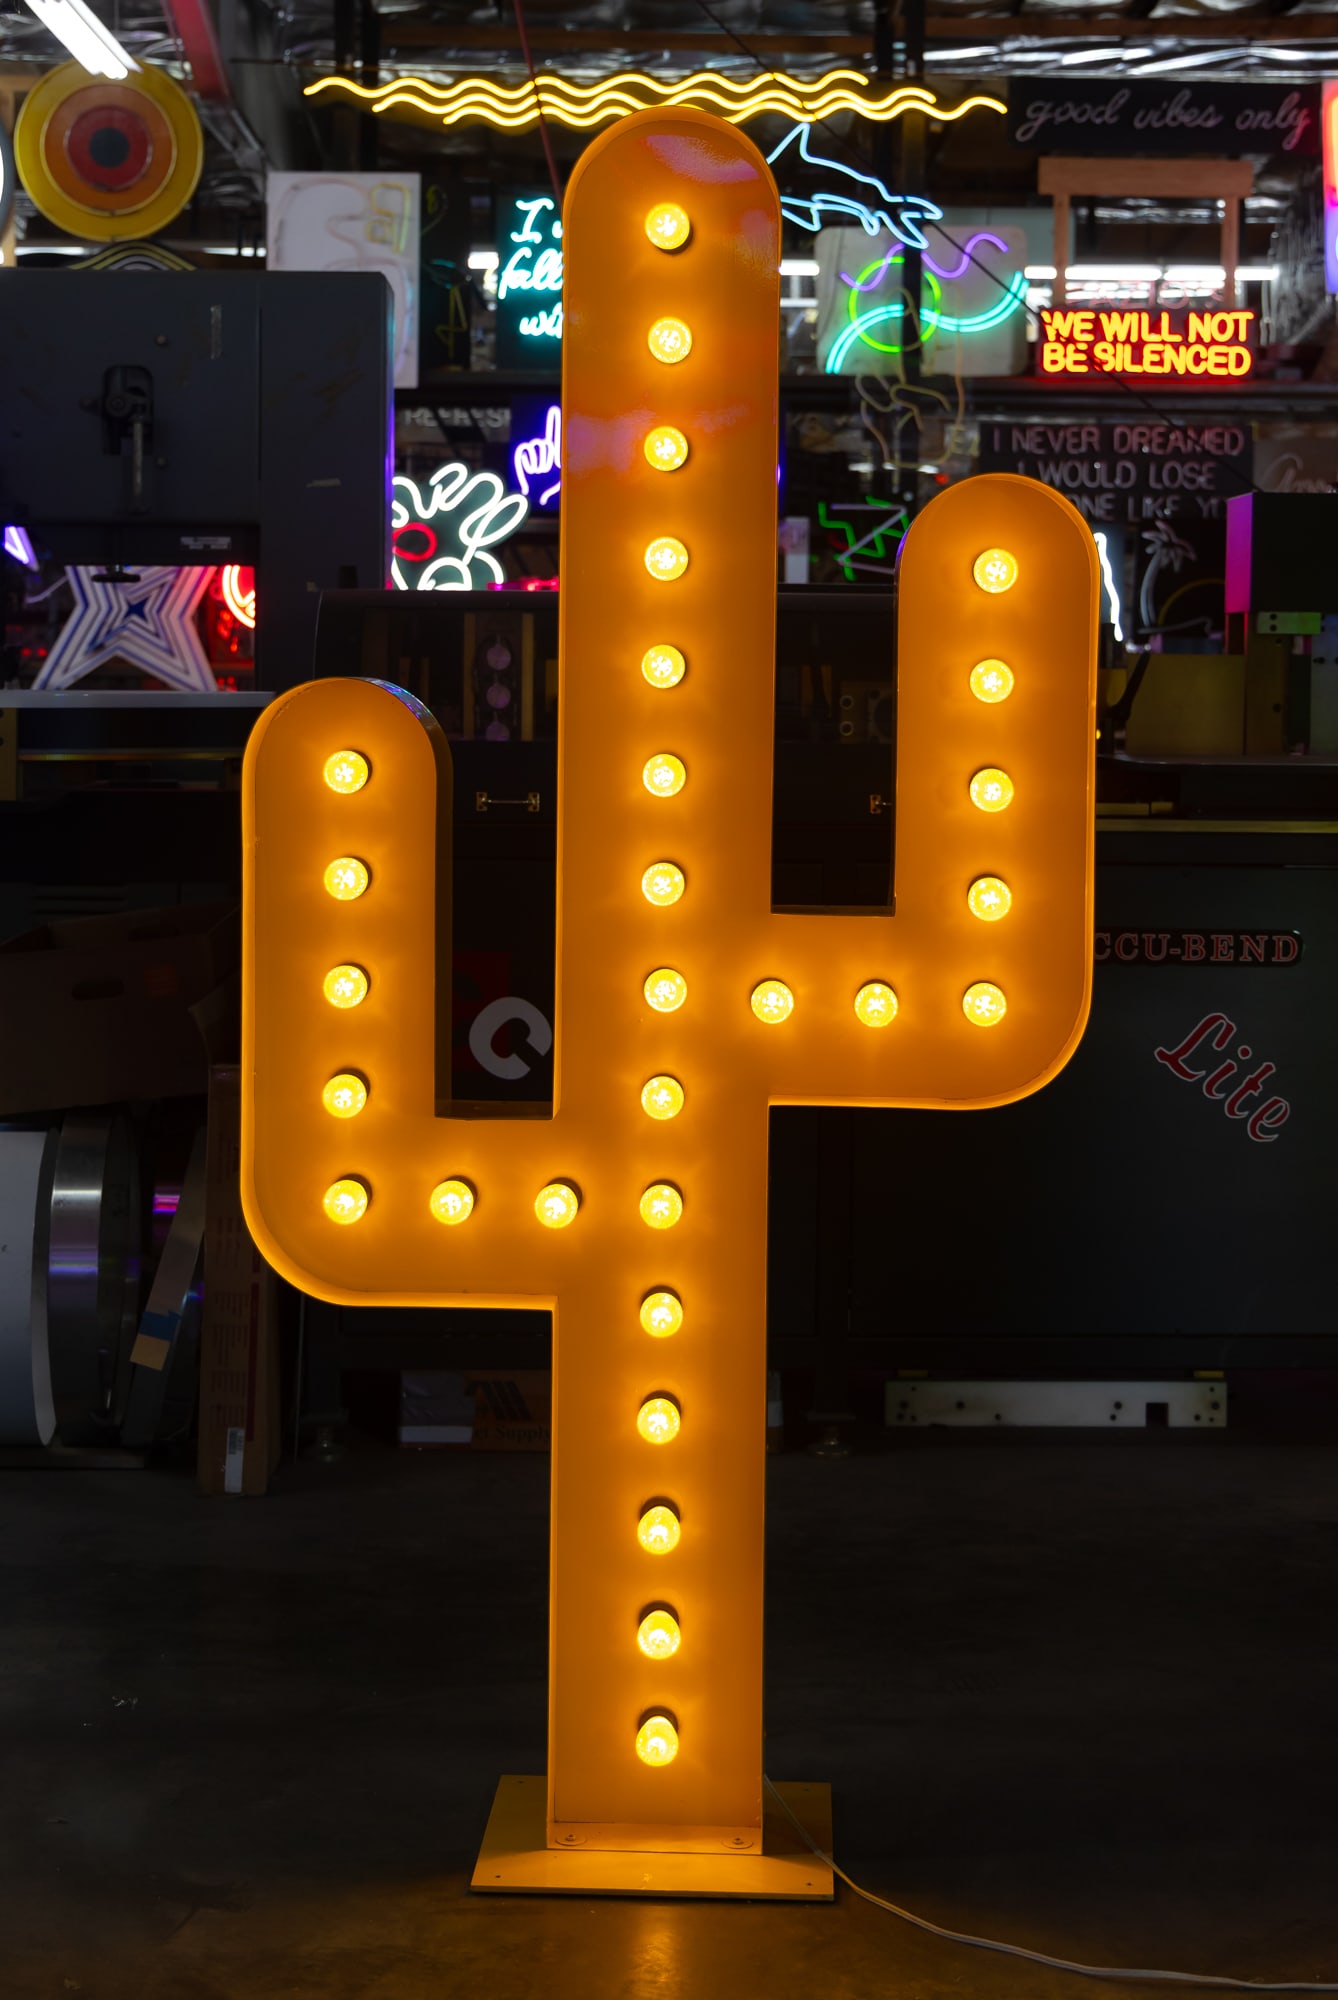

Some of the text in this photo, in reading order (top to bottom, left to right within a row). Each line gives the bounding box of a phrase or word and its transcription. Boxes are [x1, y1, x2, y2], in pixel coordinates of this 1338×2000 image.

[1015, 88, 1311, 150] good vibes only
[510, 197, 555, 244] I
[1041, 310, 1254, 342] WE WILL NOT
[1042, 342, 1252, 376] BE SILENCED
[992, 426, 1245, 456] I NEVER DREAMED
[1038, 460, 1137, 489] WOULD
[1149, 460, 1217, 490] LOSE
[1127, 494, 1181, 522] LIKE
[1094, 932, 1299, 962] CCU-BEND
[1154, 1012, 1290, 1143] Lite
